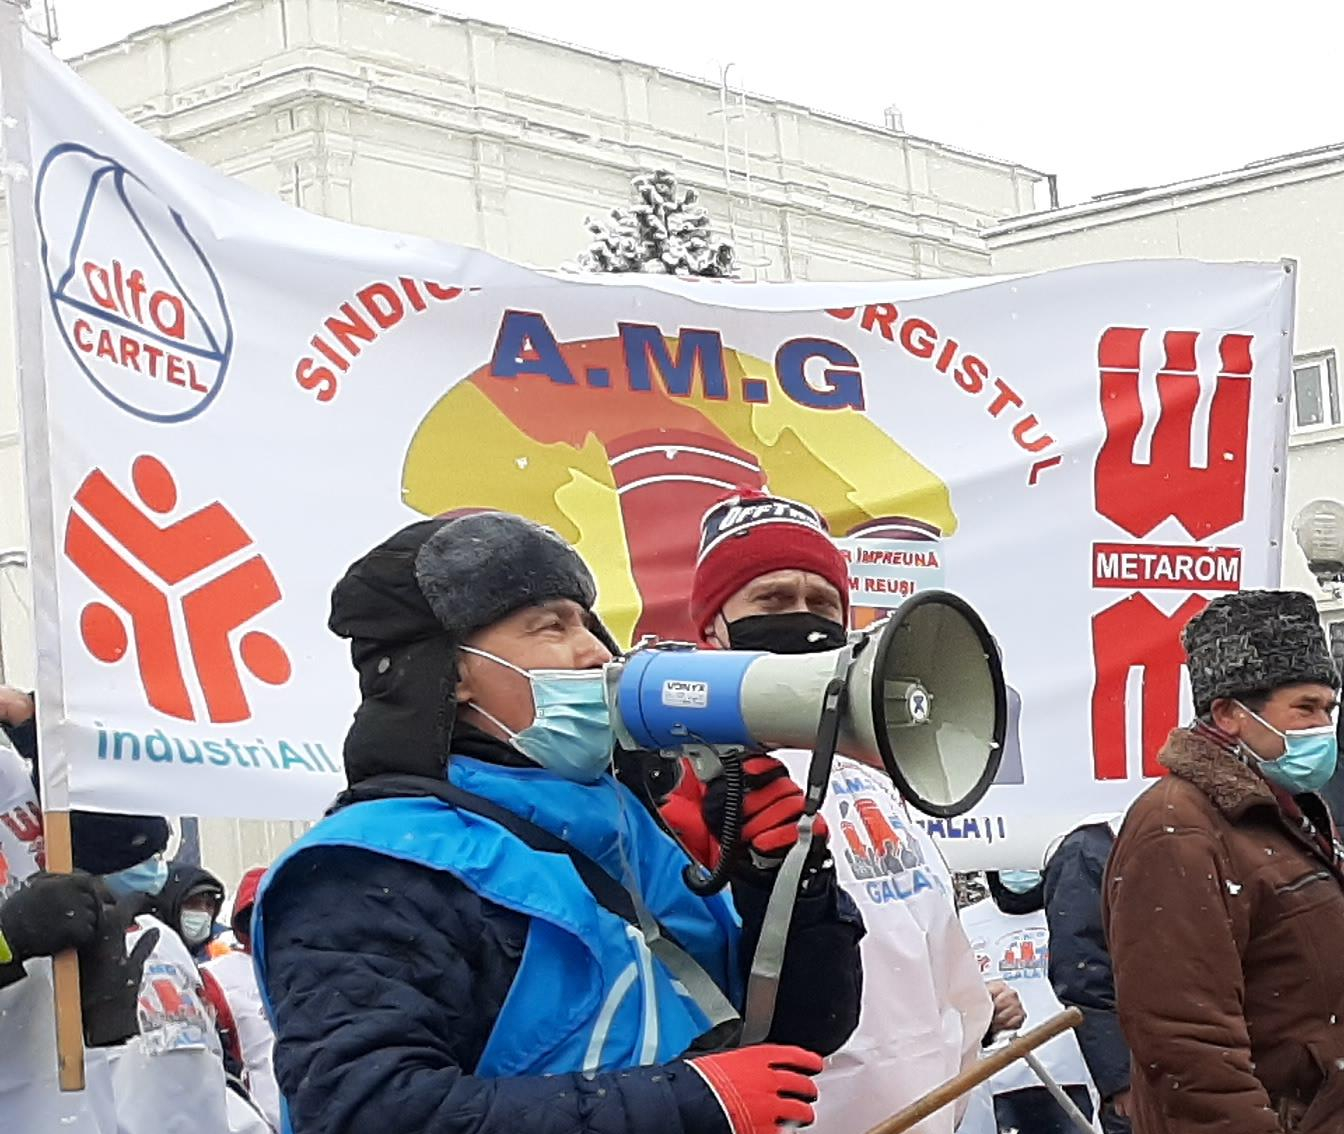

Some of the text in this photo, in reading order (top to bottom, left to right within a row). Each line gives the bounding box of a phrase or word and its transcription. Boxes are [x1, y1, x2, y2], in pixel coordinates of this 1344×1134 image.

[82, 258, 185, 340] alfa
[73, 318, 209, 393] CARTEL
[489, 309, 866, 411] A.M.G
[1096, 552, 1239, 582] METAROM
